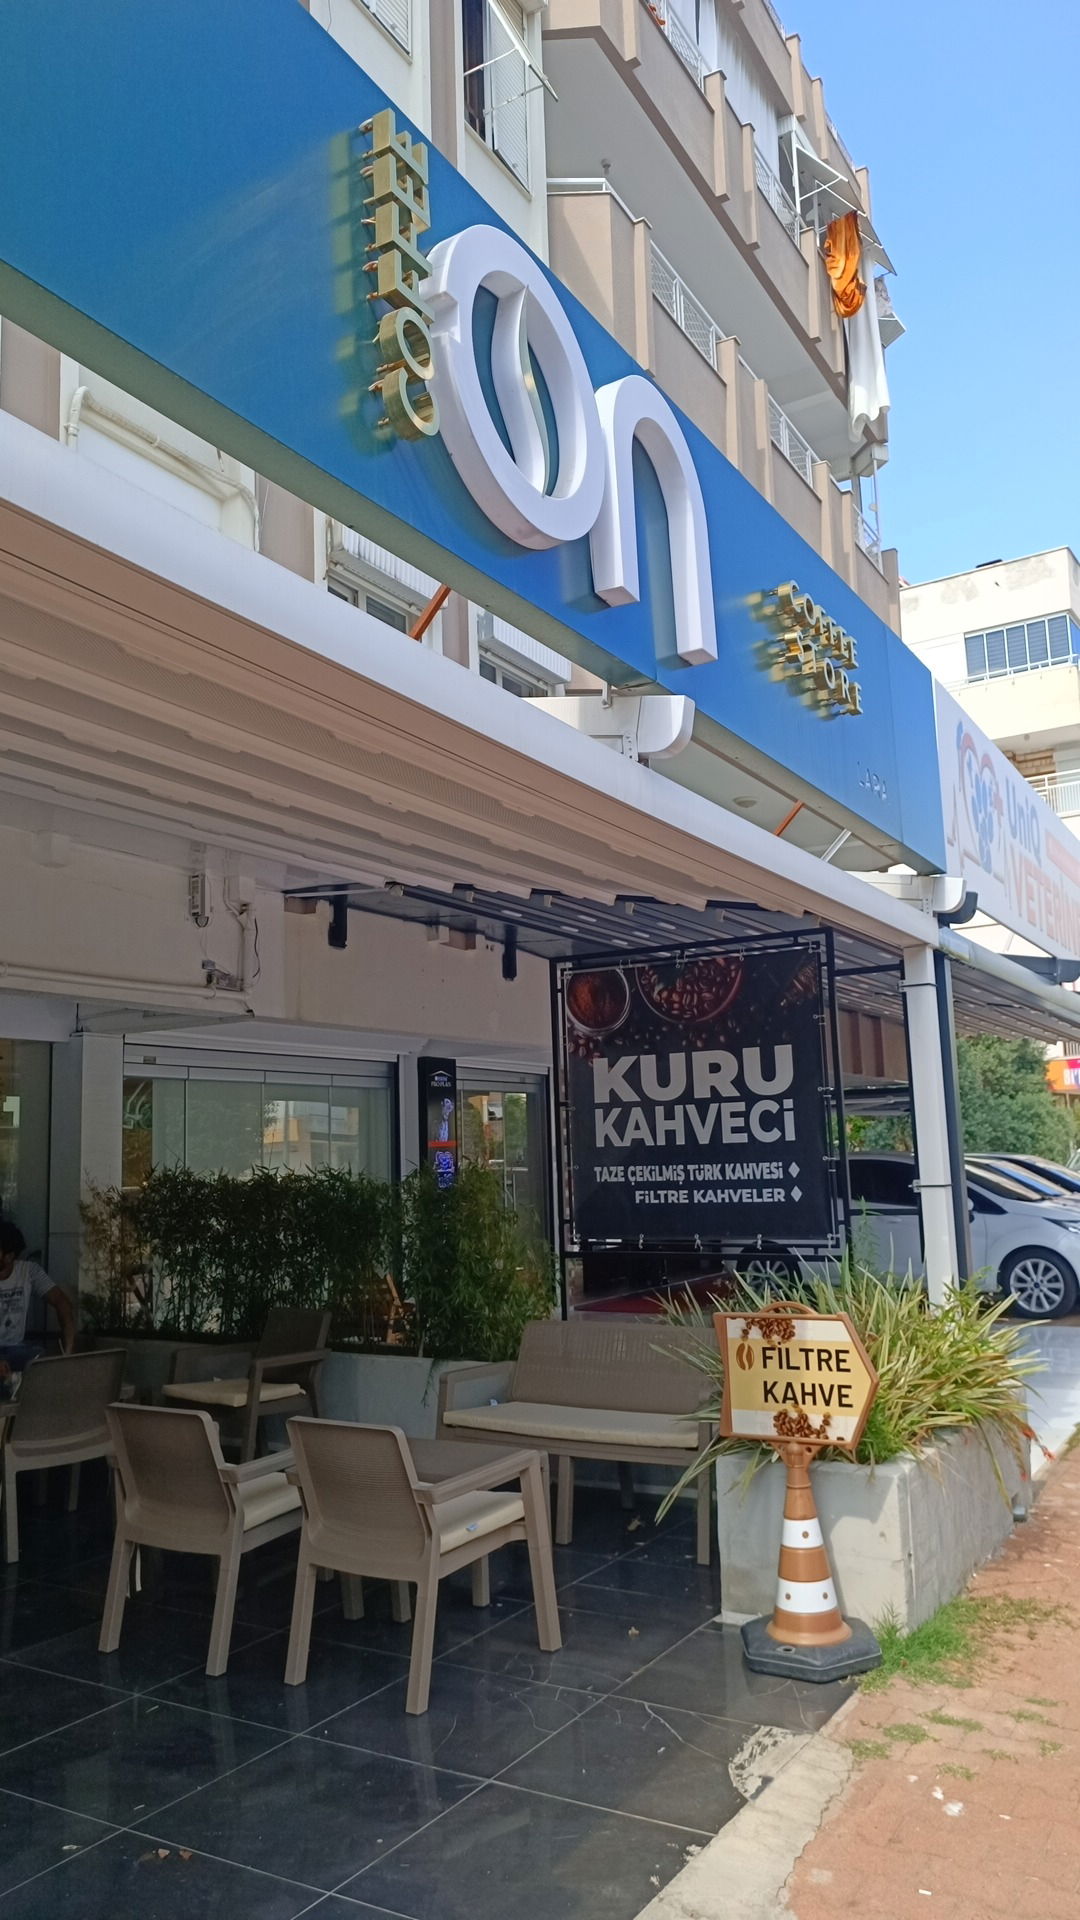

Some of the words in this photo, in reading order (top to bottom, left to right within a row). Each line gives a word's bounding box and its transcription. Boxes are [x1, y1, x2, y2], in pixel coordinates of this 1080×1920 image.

[372, 108, 440, 440] COFFEE
[778, 580, 859, 669] COFFEE
[784, 630, 863, 716] STORE
[593, 1044, 794, 1104] KURU
[594, 1166, 625, 1182] TAZE
[687, 1163, 722, 1181] TÜRK
[693, 1188, 786, 1203] KAHVELER
[762, 1342, 851, 1373] FİLTRE
[763, 1380, 853, 1408] KAHVE
